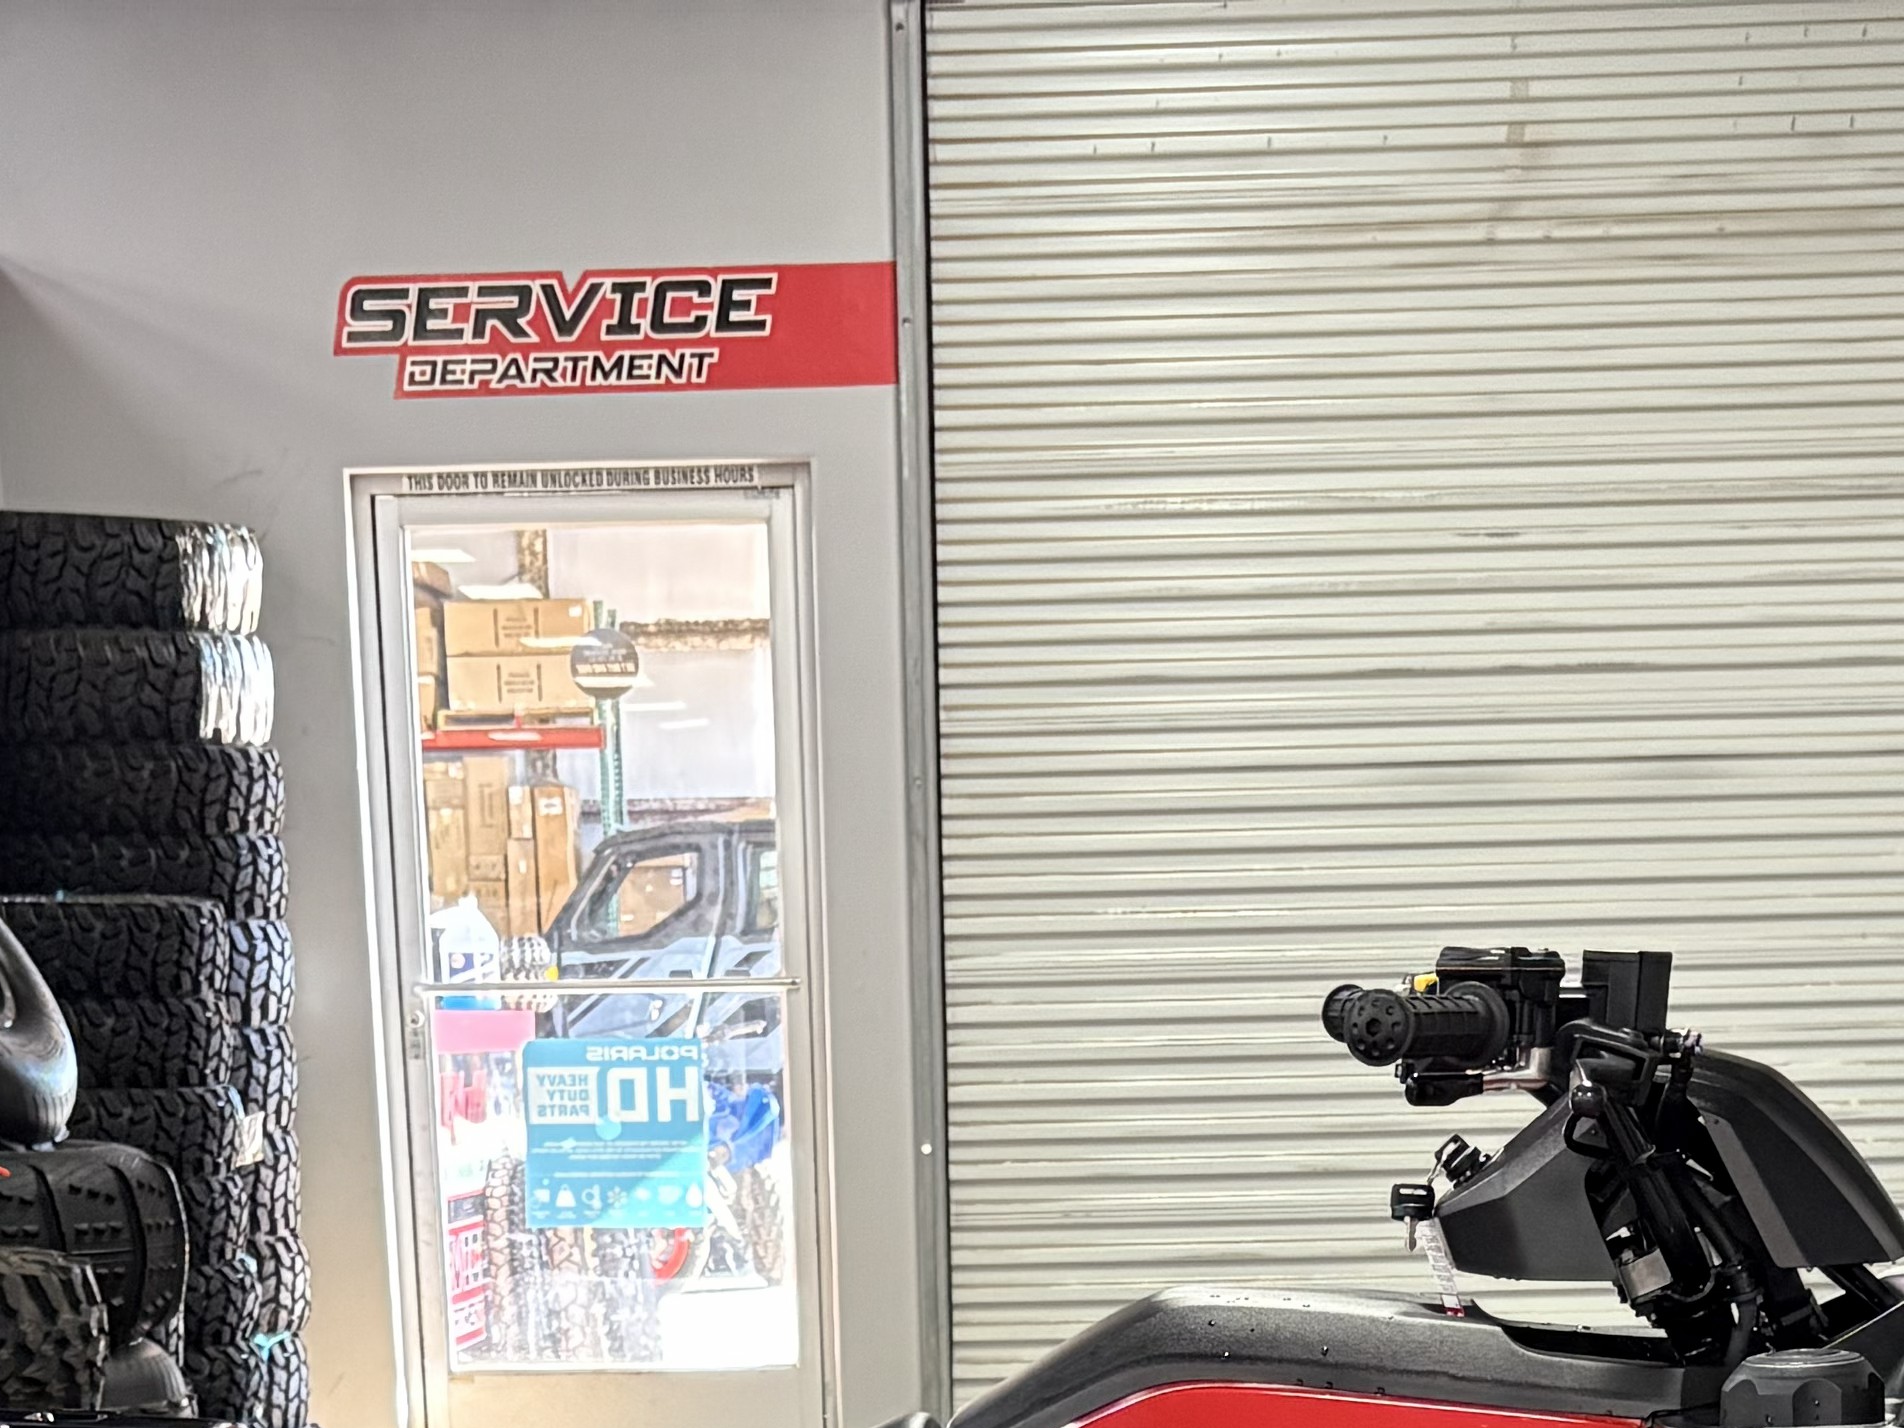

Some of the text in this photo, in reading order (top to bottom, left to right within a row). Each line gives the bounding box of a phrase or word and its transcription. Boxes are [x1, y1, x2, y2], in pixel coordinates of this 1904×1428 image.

[343, 273, 778, 347] SERVICE
[405, 349, 718, 391] DEPARTMENT
[407, 464, 755, 491] THIS DOOR TO REMAIN UNLOCKED DURING BUSINESS HOURS
